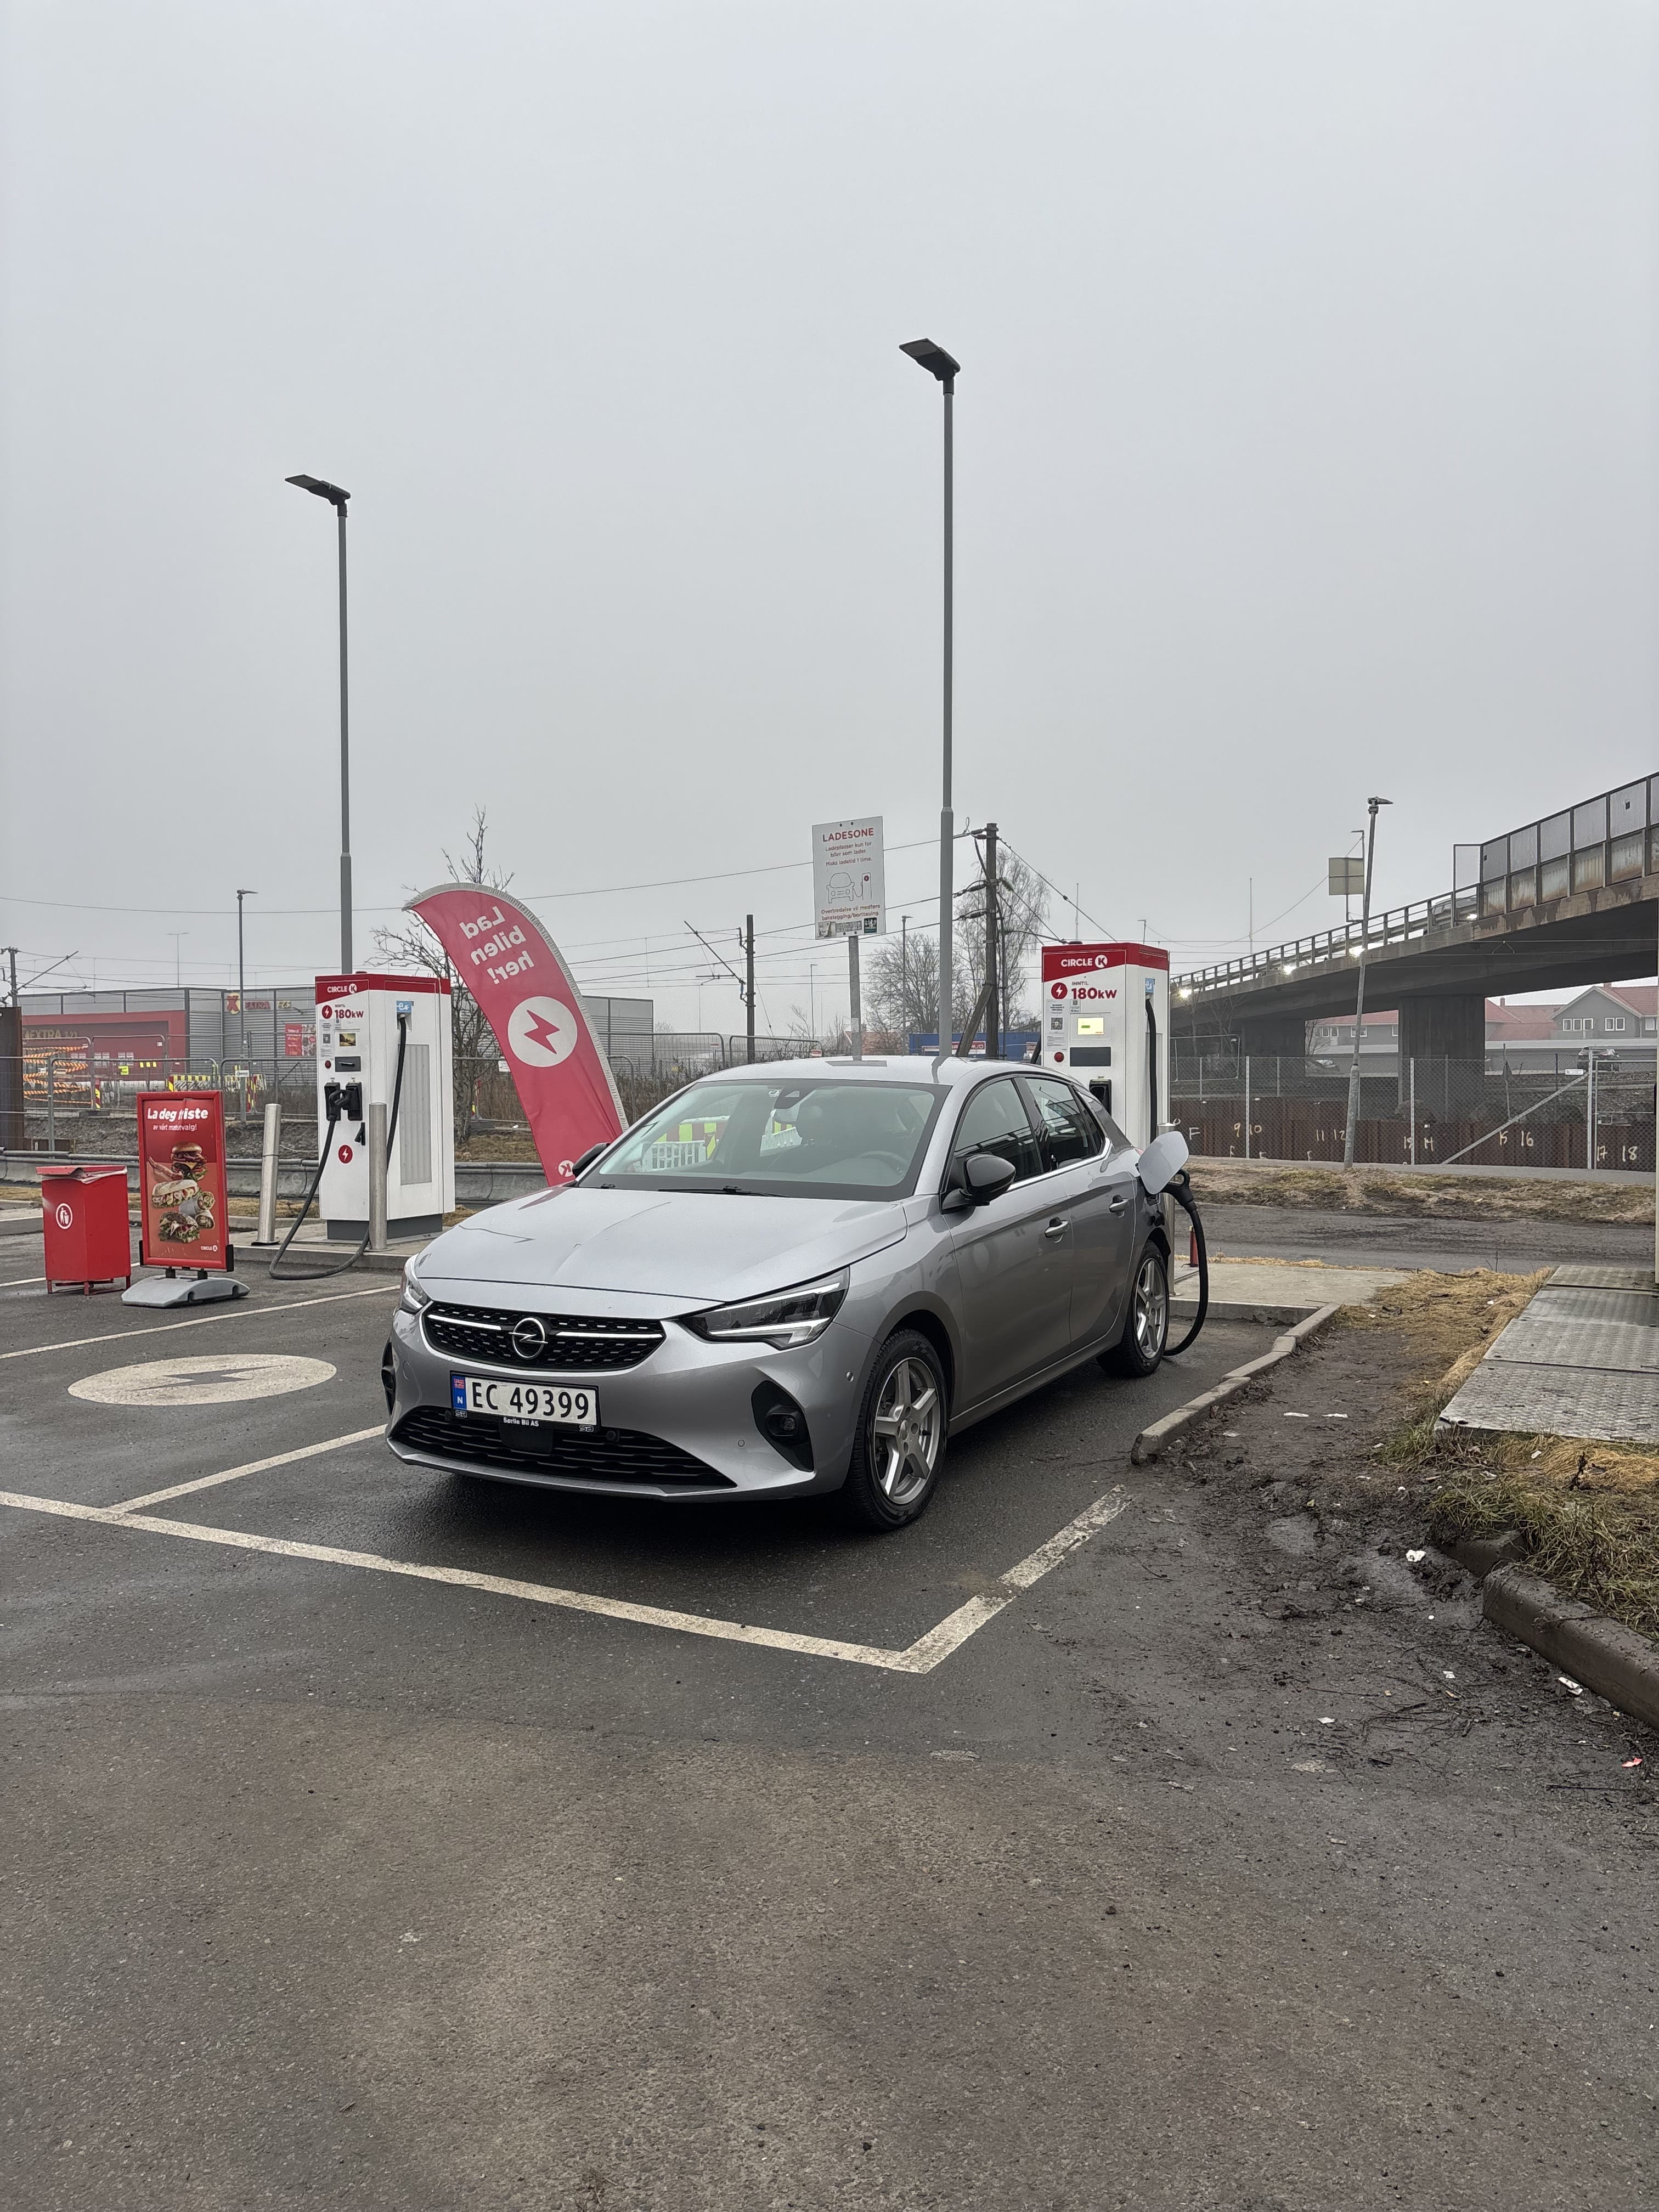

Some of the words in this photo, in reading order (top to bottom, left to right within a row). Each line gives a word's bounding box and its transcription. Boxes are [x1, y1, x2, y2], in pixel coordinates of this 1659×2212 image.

[822, 827, 874, 842] LADESONE
[1060, 958, 1093, 967] CIRCLE
[1096, 956, 1107, 968] K
[349, 984, 357, 994] K
[1071, 988, 1118, 1000] 180kW
[245, 1001, 270, 1009] EXTRA
[335, 1009, 364, 1019] 180kW
[159, 1108, 177, 1122] deg
[1234, 1122, 1241, 1138] 9
[1249, 1124, 1262, 1135] 10
[1521, 1130, 1534, 1147] 16
[1622, 1145, 1638, 1162] 18
[457, 1396, 463, 1404] N
[472, 1381, 499, 1410] EC
[510, 1387, 589, 1420] 49399
